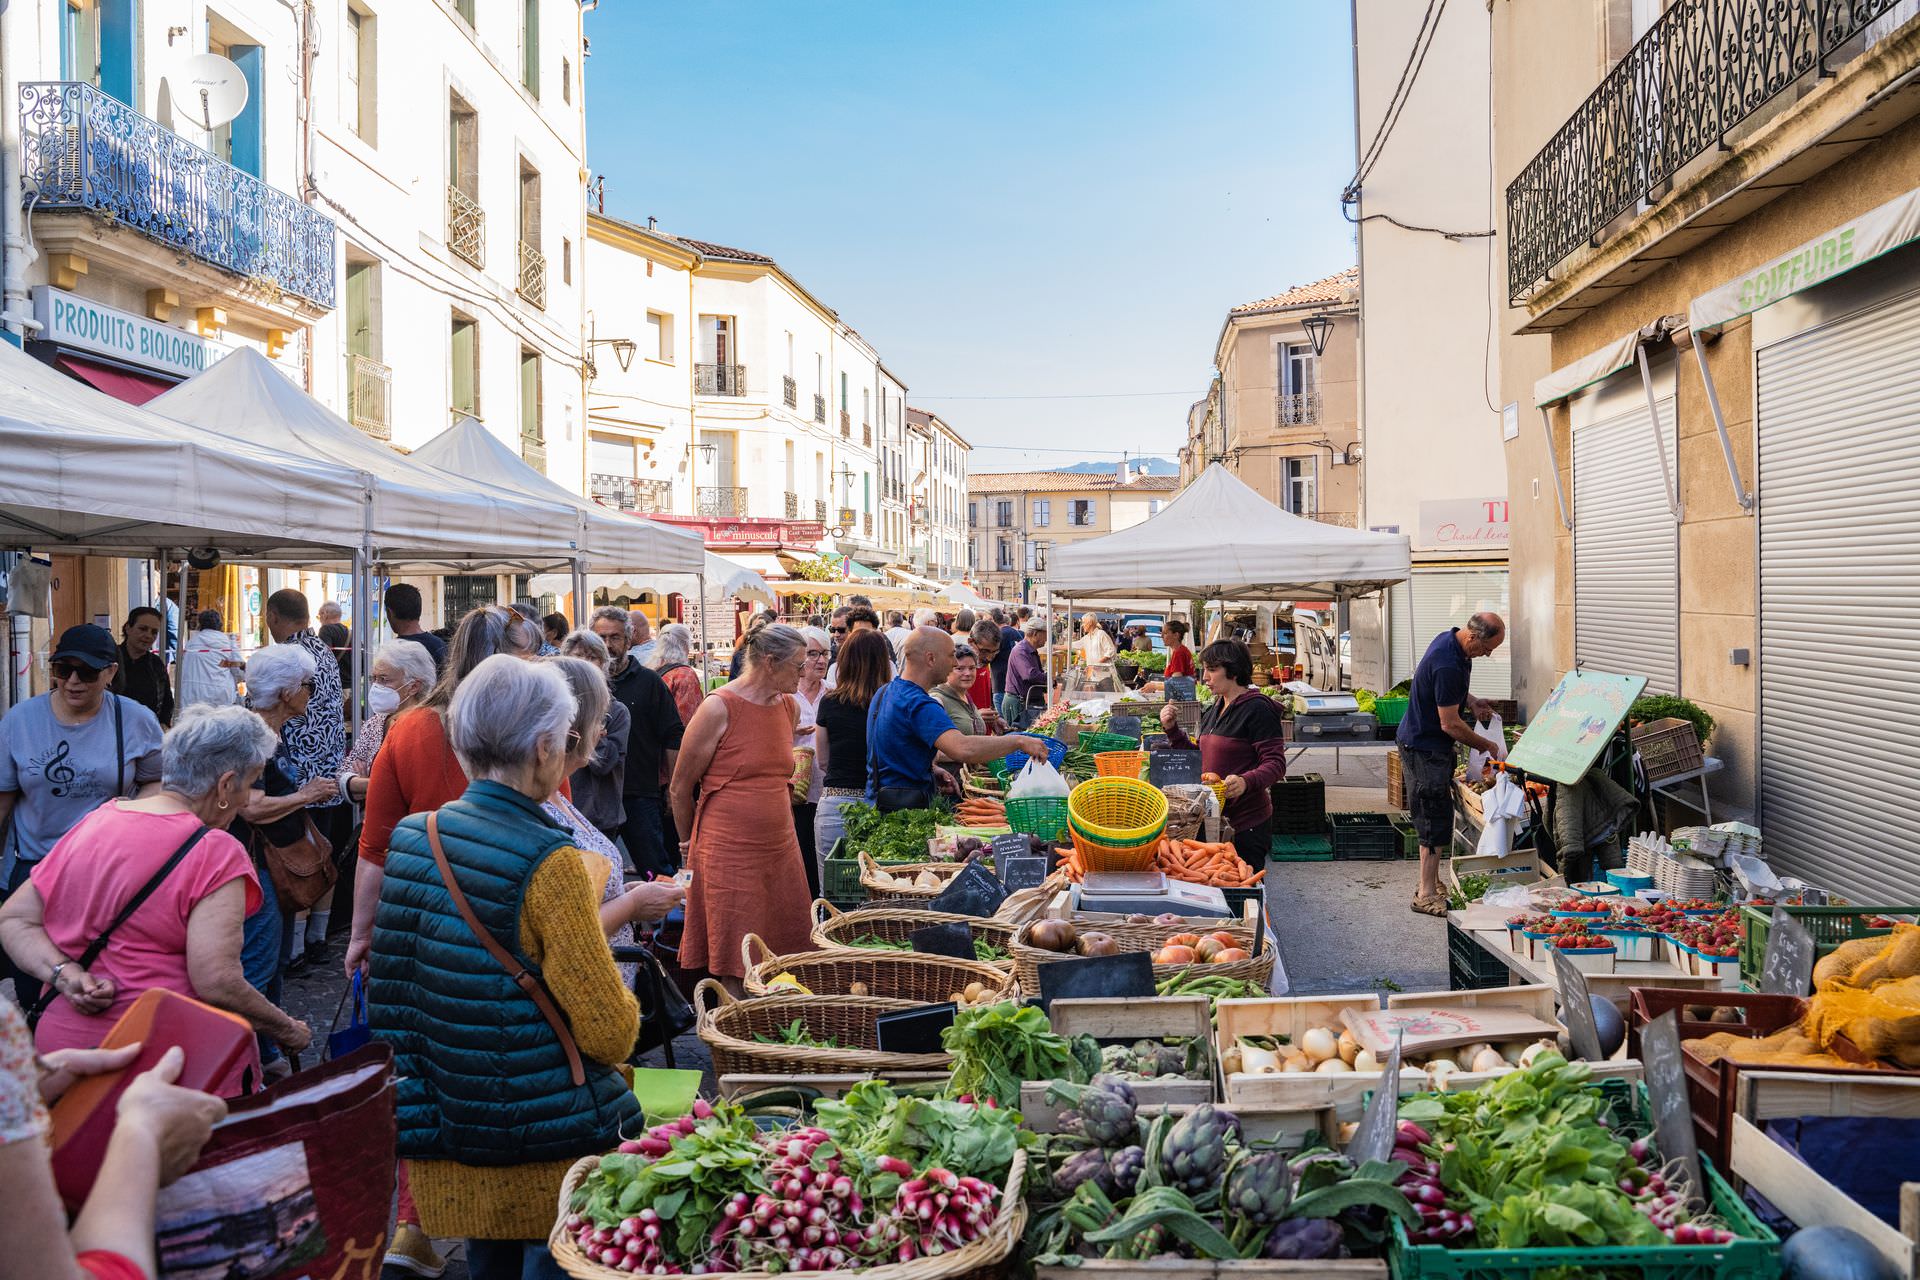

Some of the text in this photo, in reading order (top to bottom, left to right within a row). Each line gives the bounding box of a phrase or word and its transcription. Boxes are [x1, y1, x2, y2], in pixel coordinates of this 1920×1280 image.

[1738, 228, 1856, 310] COIFFURE
[55, 298, 134, 351] PRODUITS
[713, 527, 778, 540] le minuscule
